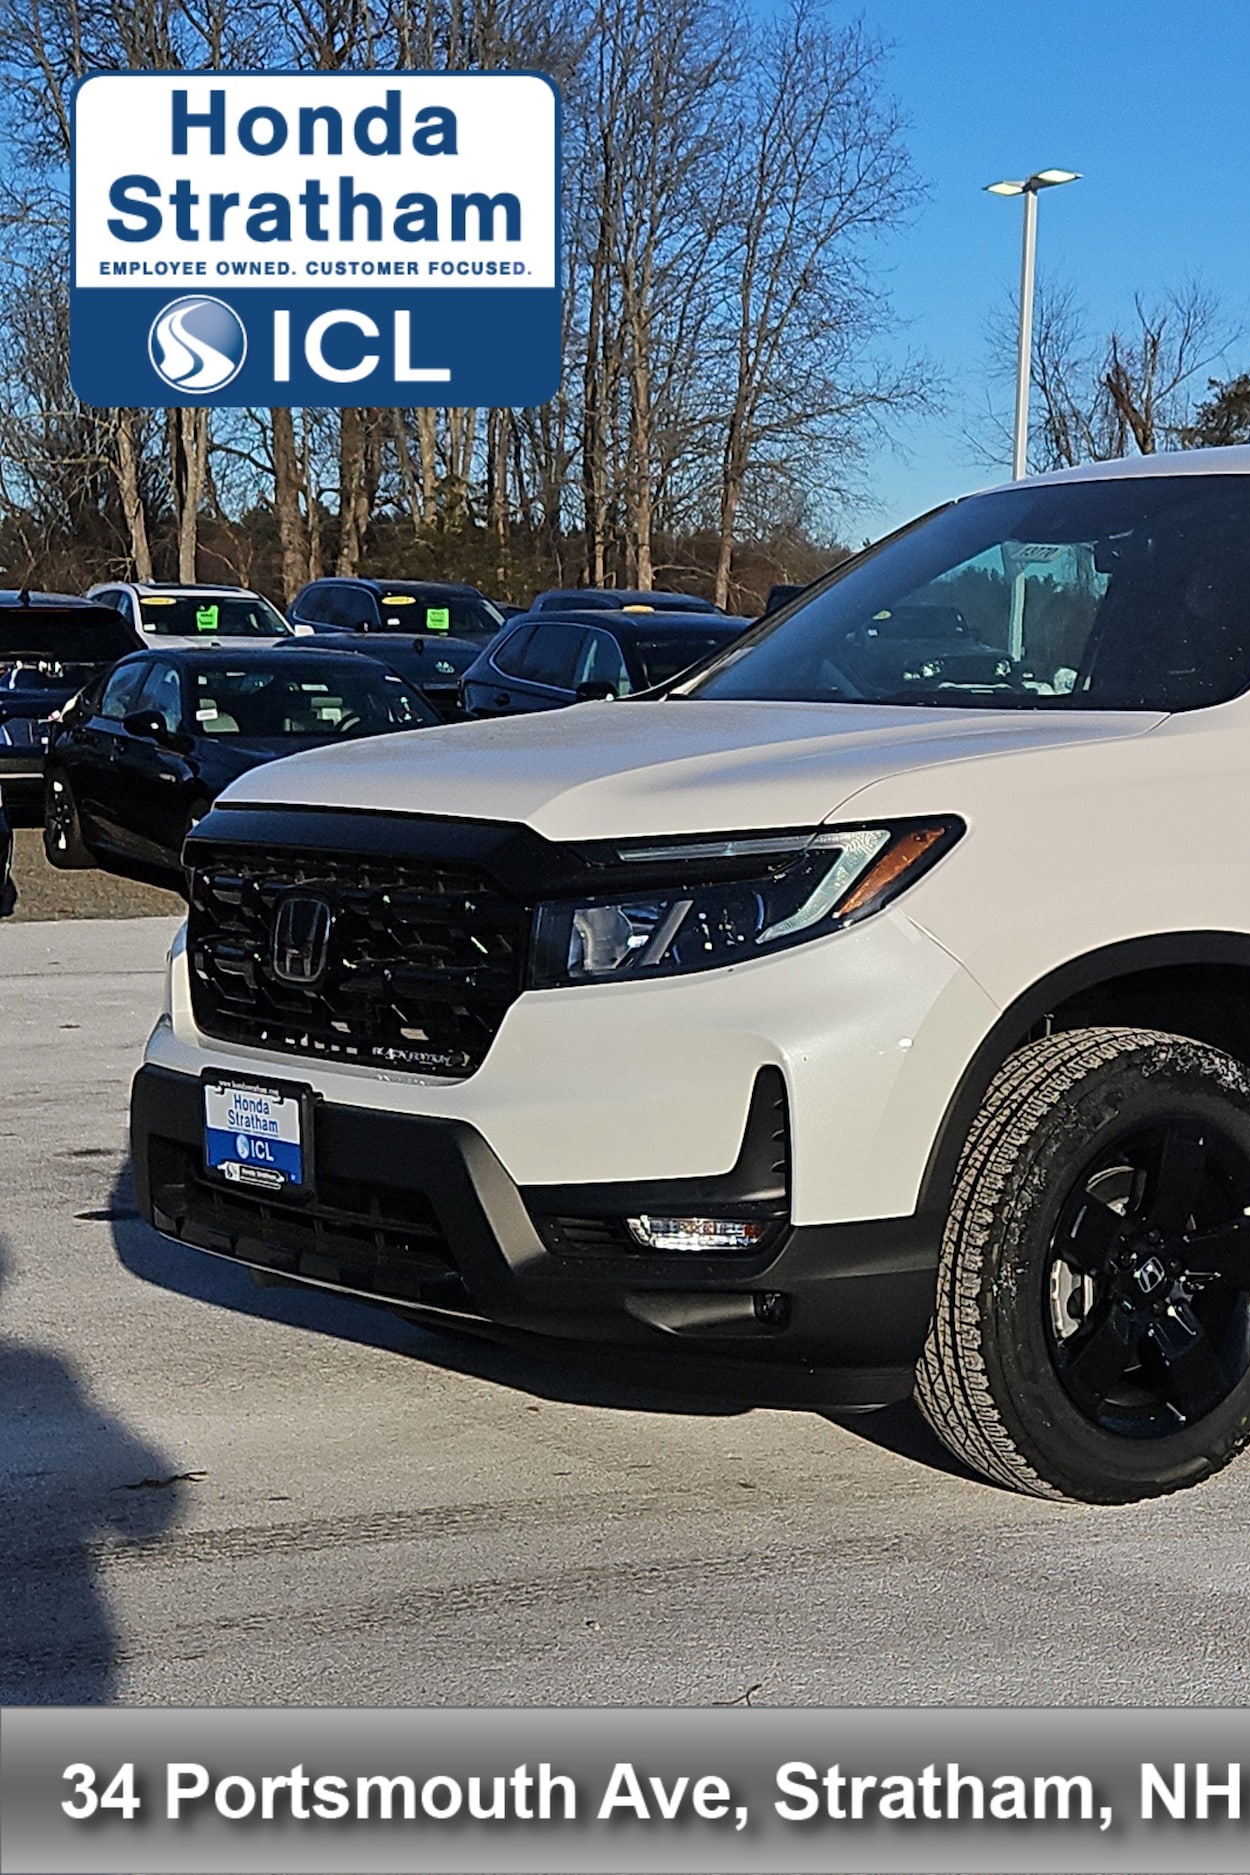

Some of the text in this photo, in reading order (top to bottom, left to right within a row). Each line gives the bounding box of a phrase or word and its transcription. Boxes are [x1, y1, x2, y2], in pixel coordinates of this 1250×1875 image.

[233, 1094, 270, 1116] Honda
[227, 1109, 279, 1133] Stratham
[250, 1139, 274, 1162] ICL
